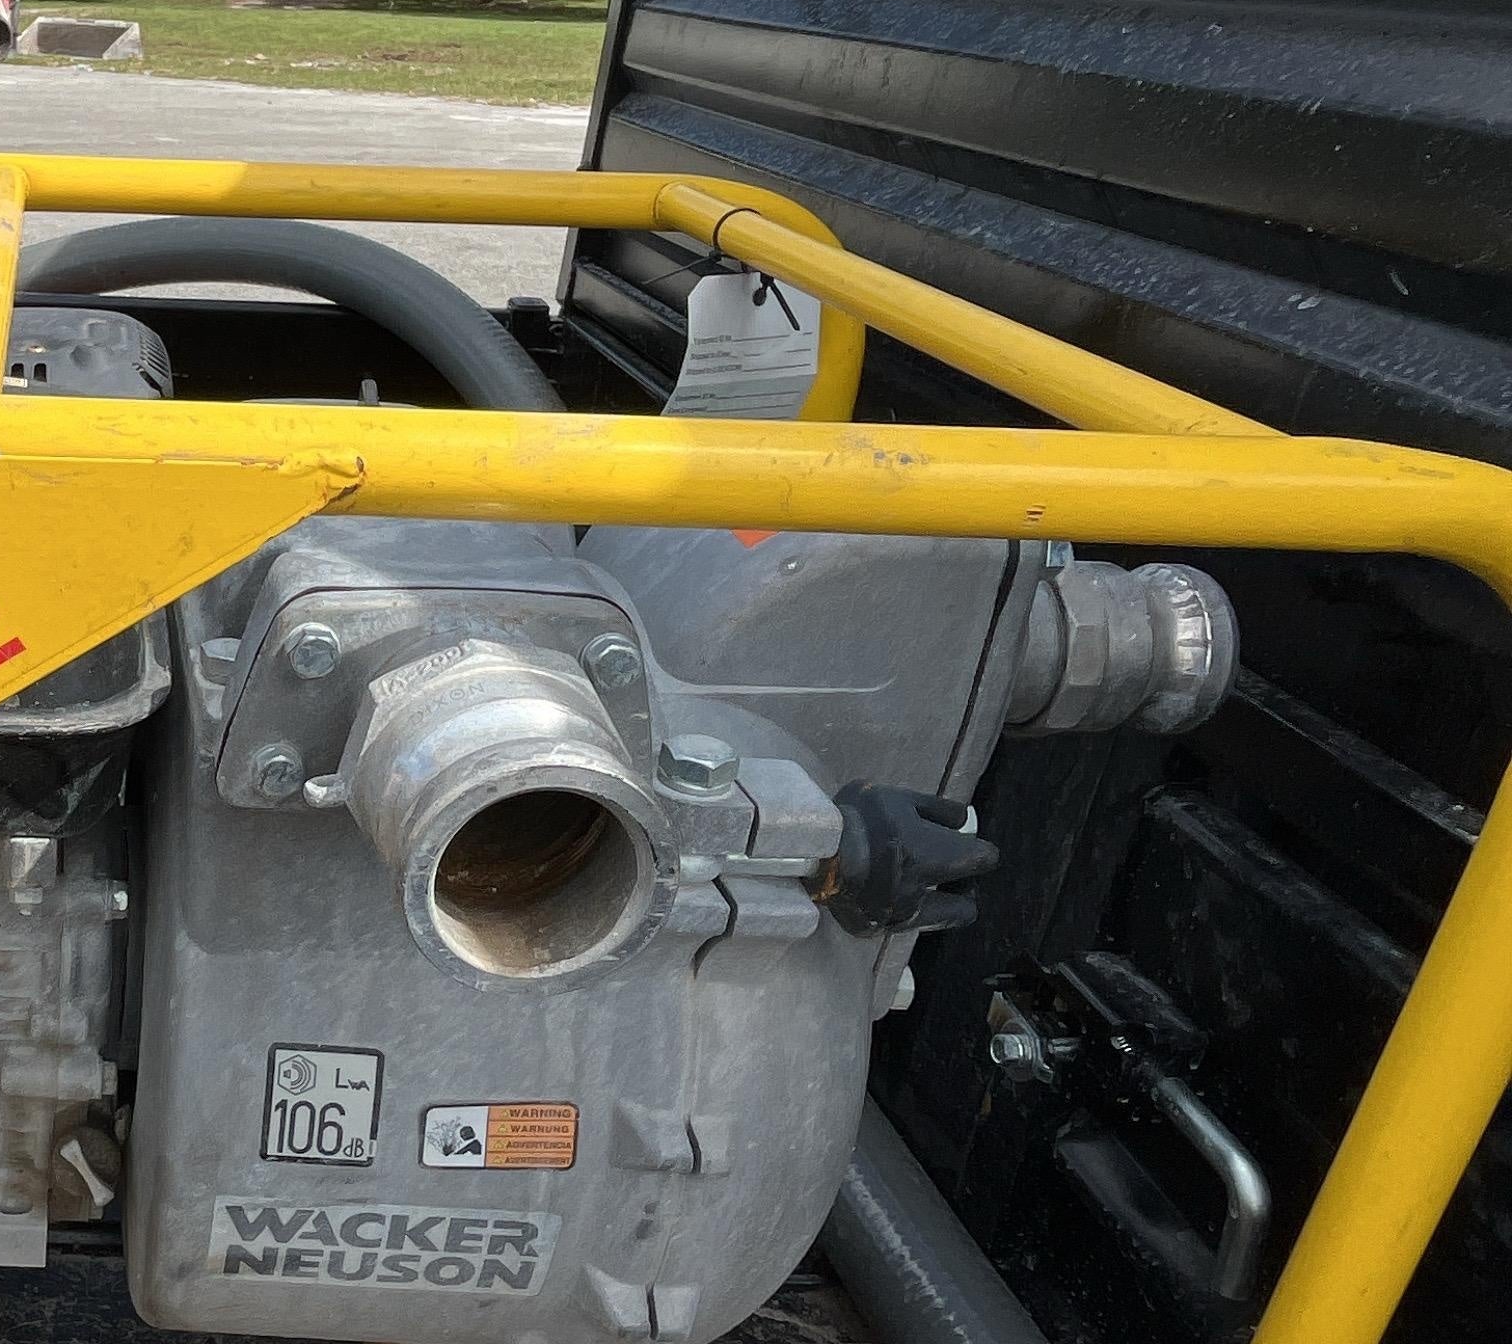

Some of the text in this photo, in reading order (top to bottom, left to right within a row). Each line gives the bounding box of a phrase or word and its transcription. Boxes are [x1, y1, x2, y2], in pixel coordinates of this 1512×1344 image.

[274, 1099, 364, 1158] 106 dB
[509, 1108, 571, 1119] WARNING
[510, 1124, 569, 1134] WARNUNG
[225, 1205, 539, 1257] WACKER
[223, 1245, 538, 1290] NEUSON
